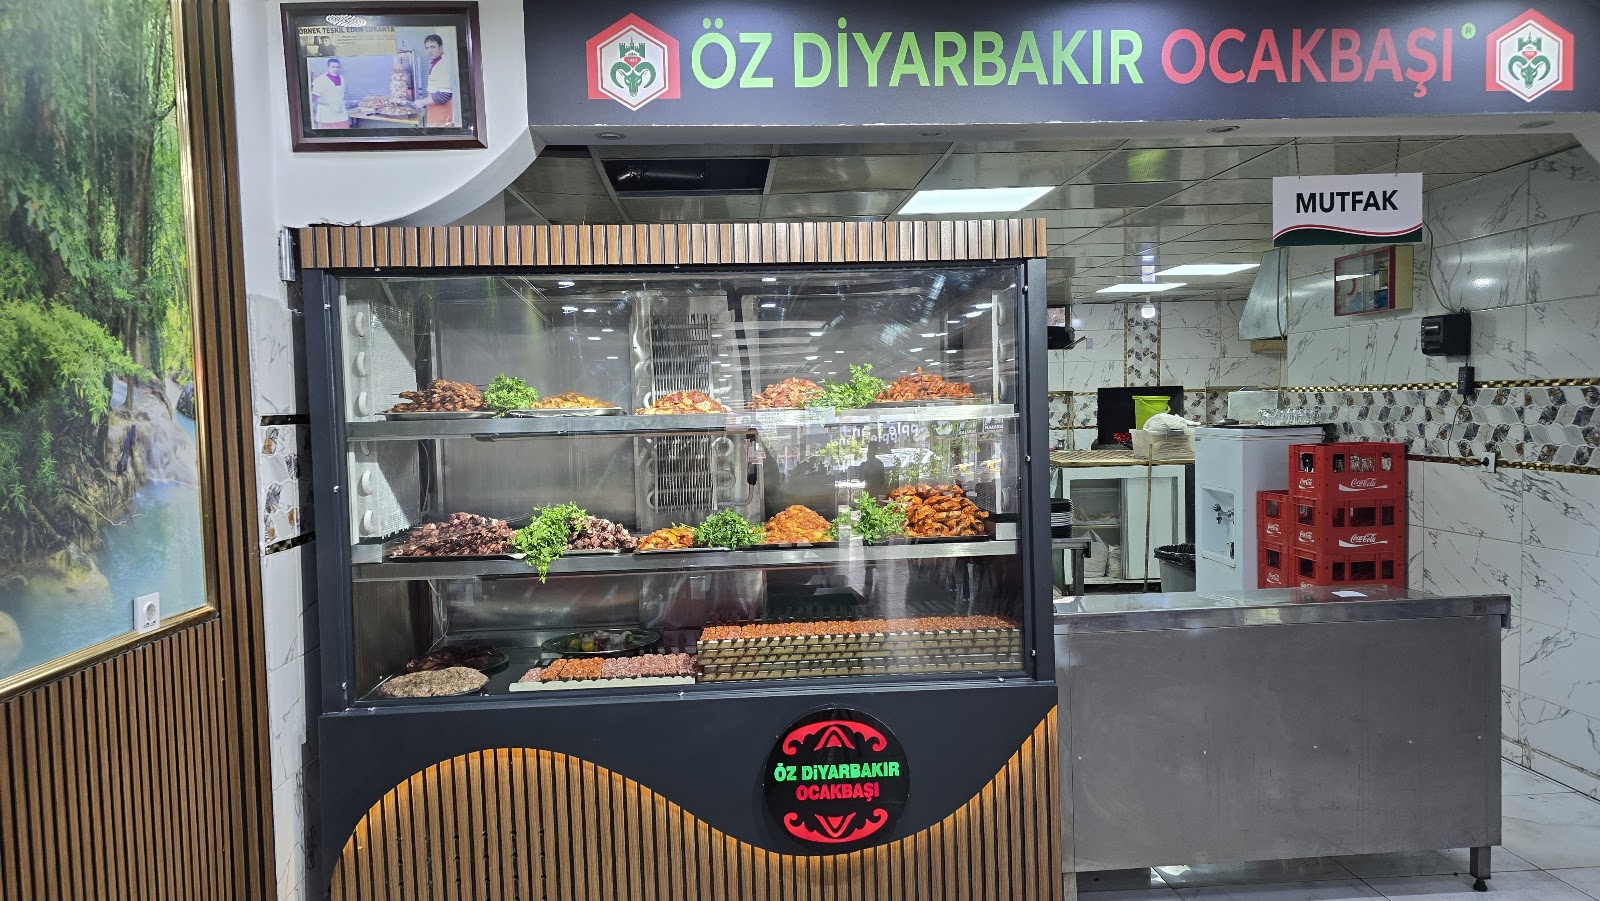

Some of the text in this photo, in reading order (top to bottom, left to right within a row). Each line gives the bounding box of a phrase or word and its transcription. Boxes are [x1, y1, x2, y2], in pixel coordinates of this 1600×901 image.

[691, 17, 774, 89] ÖZ
[793, 17, 1144, 88] DİYARBAKIR
[1161, 27, 1452, 98] OCAKBAŞI
[1296, 189, 1399, 214] MUTFAK
[773, 761, 900, 782] ÖZ DİYARBAKIR
[795, 782, 880, 802] OCAKBAŞI
